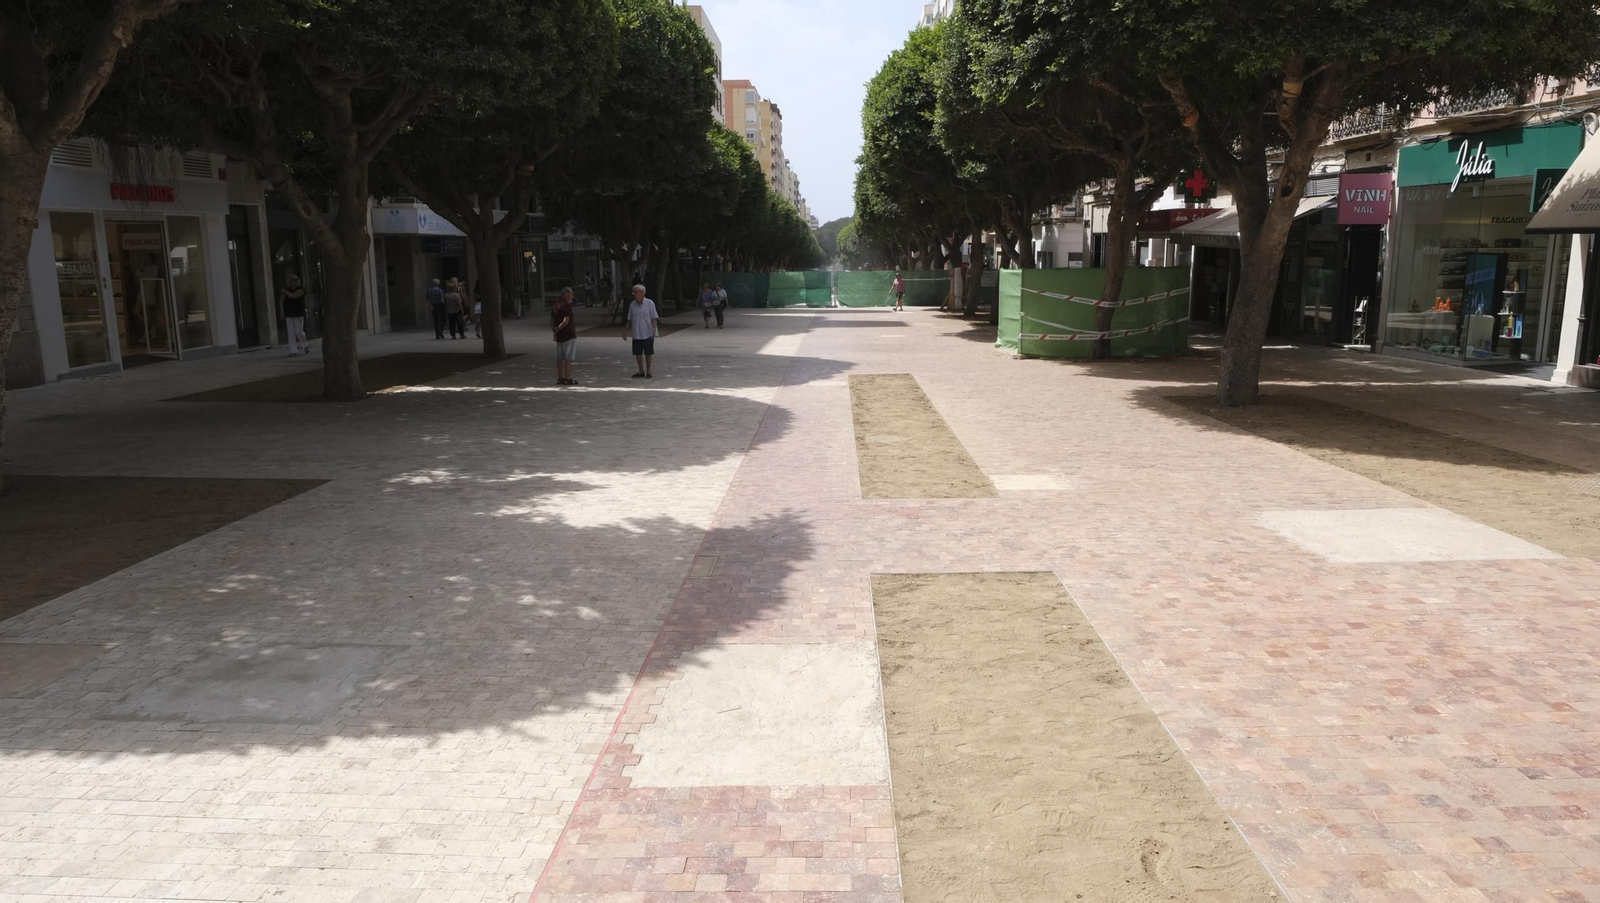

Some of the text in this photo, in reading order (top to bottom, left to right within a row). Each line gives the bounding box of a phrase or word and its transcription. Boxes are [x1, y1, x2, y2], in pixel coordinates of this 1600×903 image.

[1345, 189, 1387, 202] VINH
[125, 238, 159, 246] PIKOLINOS
[1191, 235, 1230, 246] FARMACIA
[57, 263, 93, 274] REBAJAS
